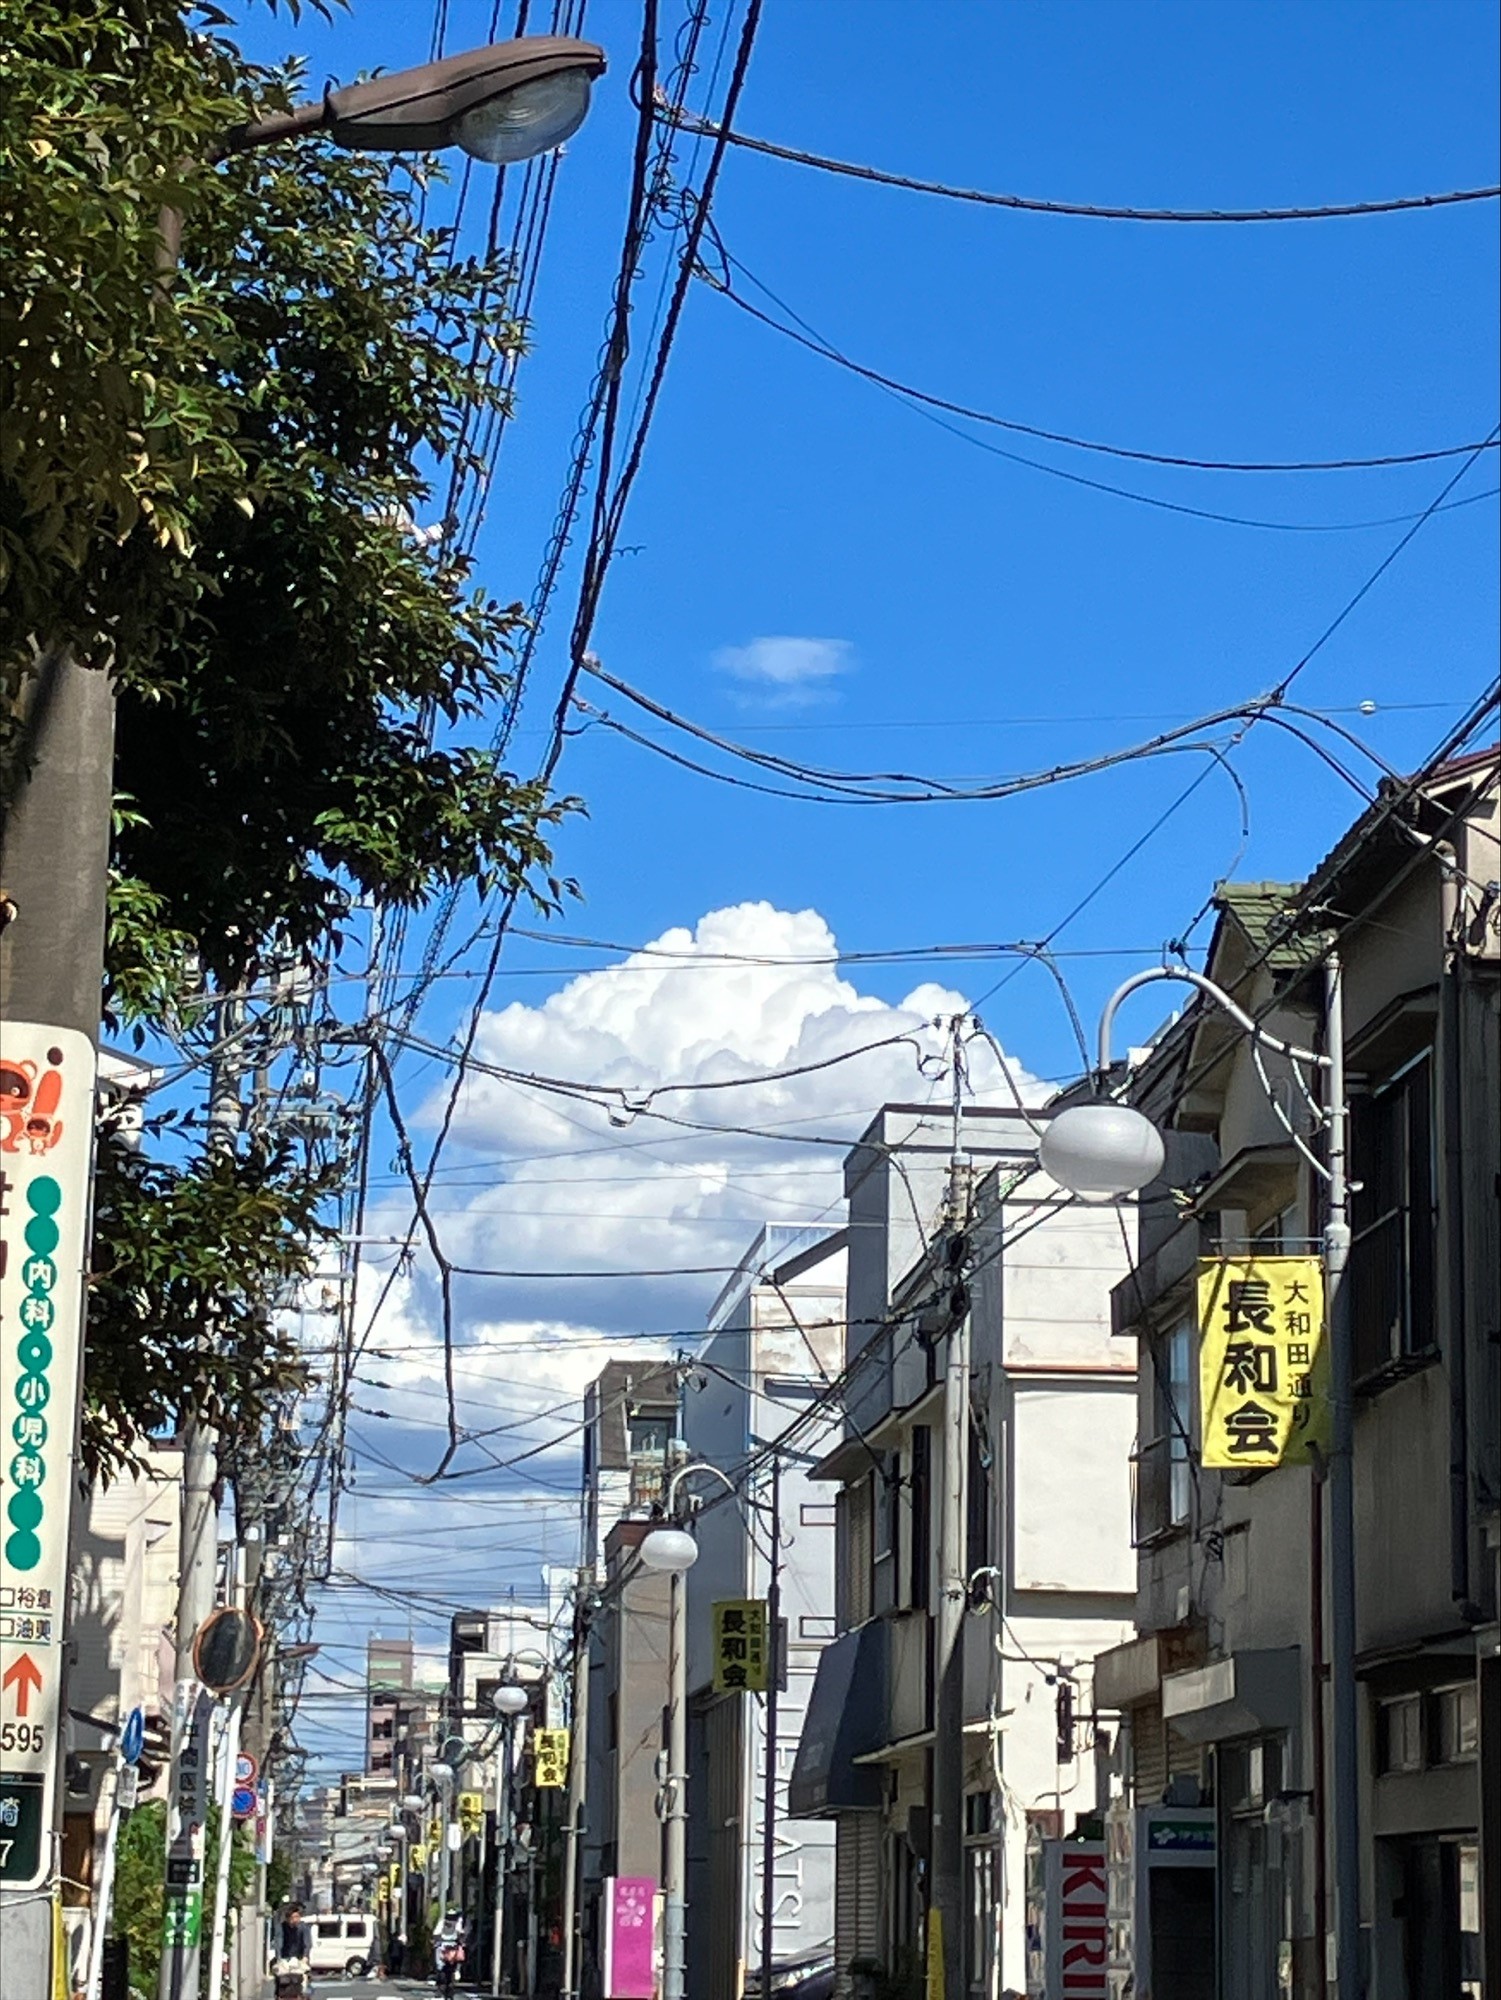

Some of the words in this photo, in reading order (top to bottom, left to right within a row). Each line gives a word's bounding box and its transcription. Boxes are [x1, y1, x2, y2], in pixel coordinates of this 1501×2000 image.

[1222, 1280, 1279, 1455] 長和会
[1284, 1279, 1313, 1431] 大和田通り
[721, 1609, 747, 1688] 長和会
[0, 1723, 45, 1753] 595
[1062, 1853, 1106, 2000] KIRI
